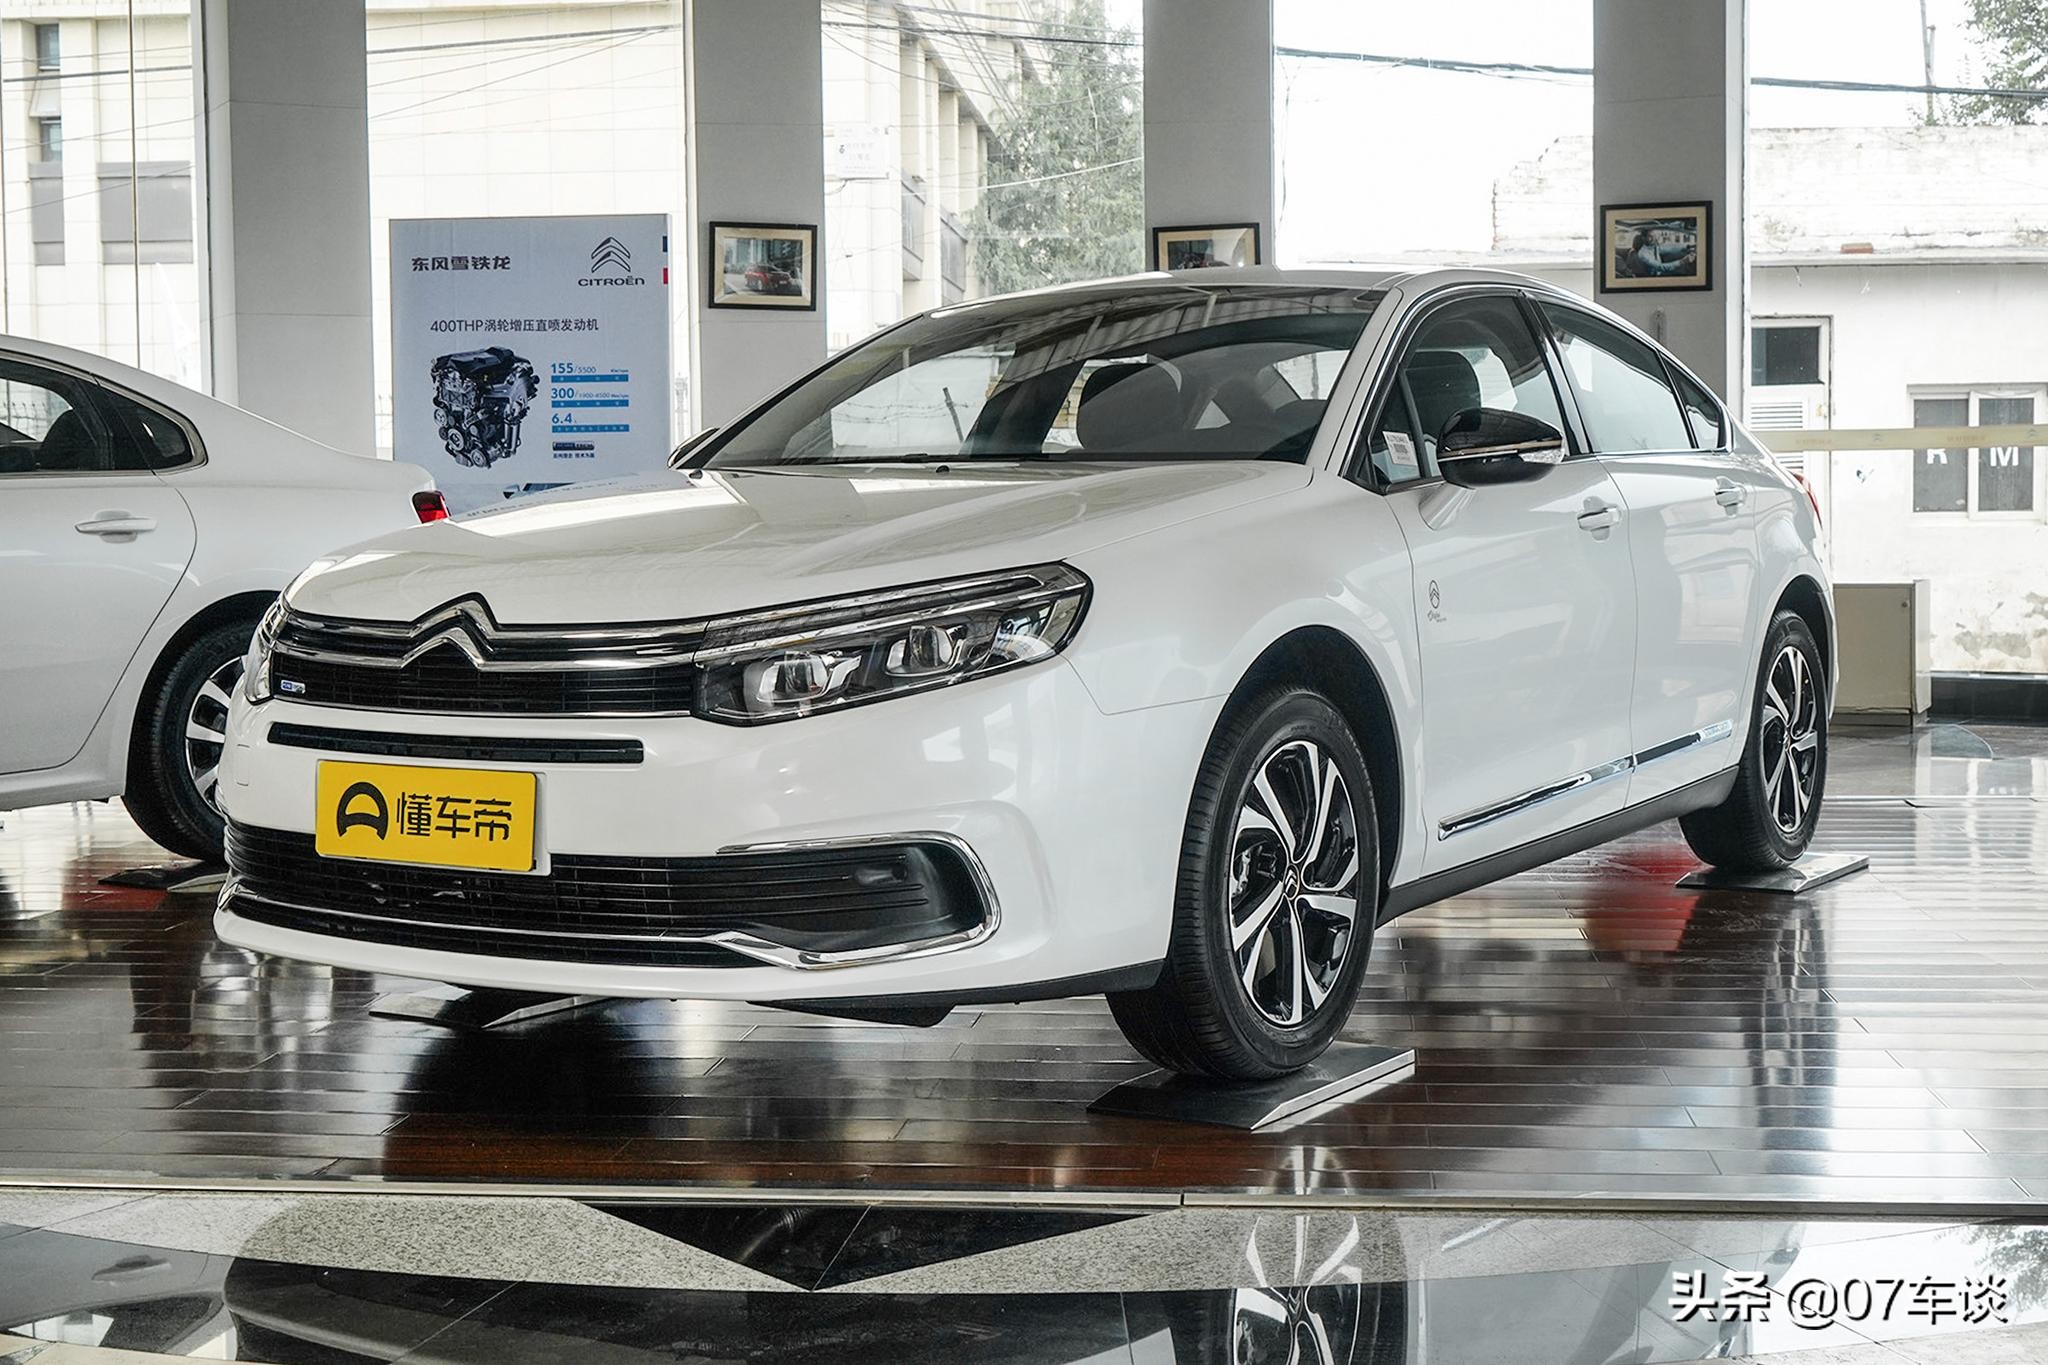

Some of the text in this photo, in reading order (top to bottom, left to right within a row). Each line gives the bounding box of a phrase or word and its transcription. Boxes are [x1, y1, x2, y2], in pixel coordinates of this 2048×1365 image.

[411, 256, 511, 272] 东风雪铁龙
[430, 318, 599, 332] 400THP涡轮增压直喷发动机
[396, 792, 512, 841] 懂车帝
